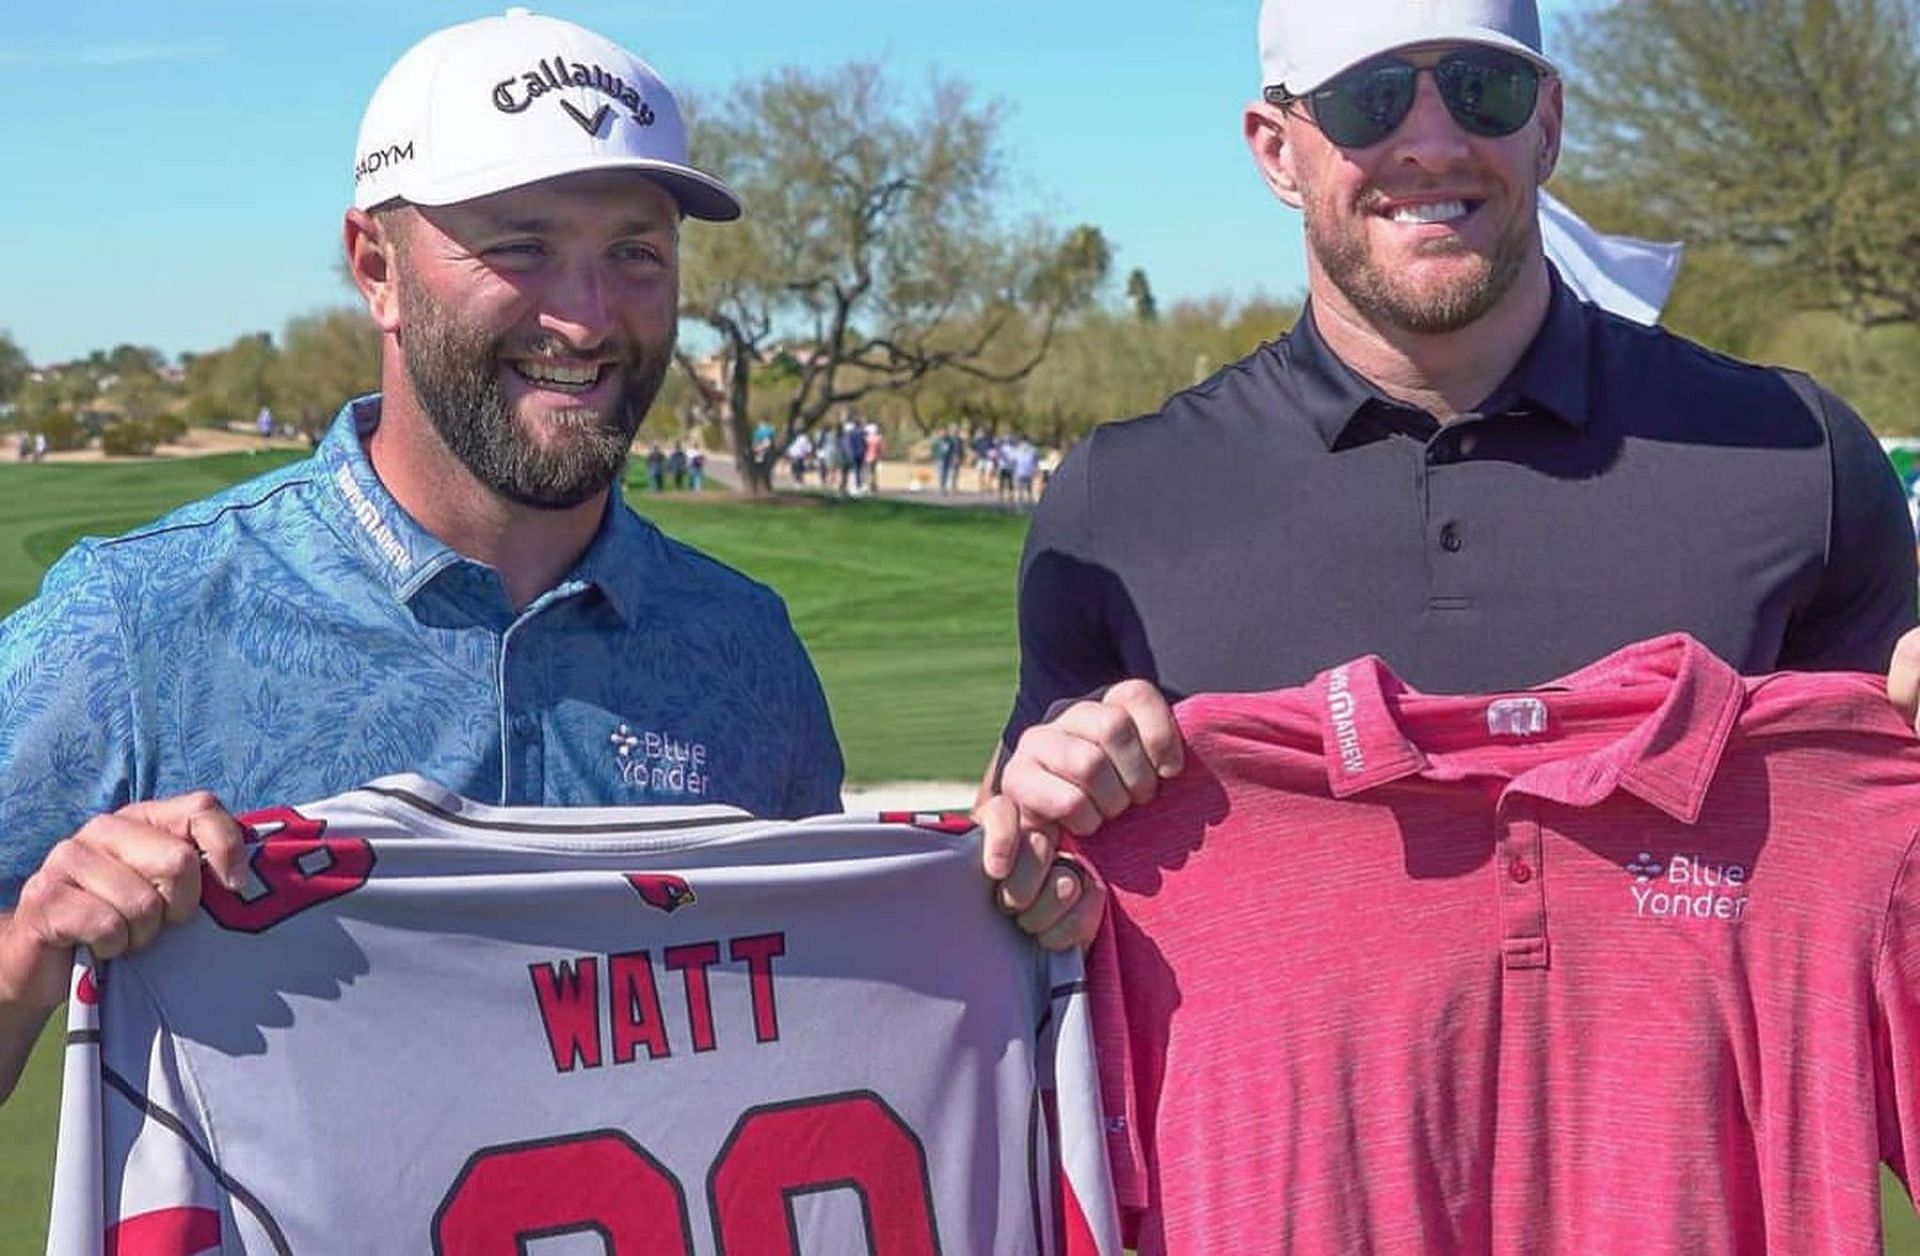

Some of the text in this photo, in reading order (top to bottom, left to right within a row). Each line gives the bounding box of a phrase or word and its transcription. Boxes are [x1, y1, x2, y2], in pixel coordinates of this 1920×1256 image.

[493, 56, 655, 127] Callaway
[645, 731, 706, 764] Blue
[616, 757, 710, 796] Yonder
[1669, 855, 1745, 887] Blue
[1630, 886, 1749, 919] Yonder
[528, 932, 785, 1073] WATT
